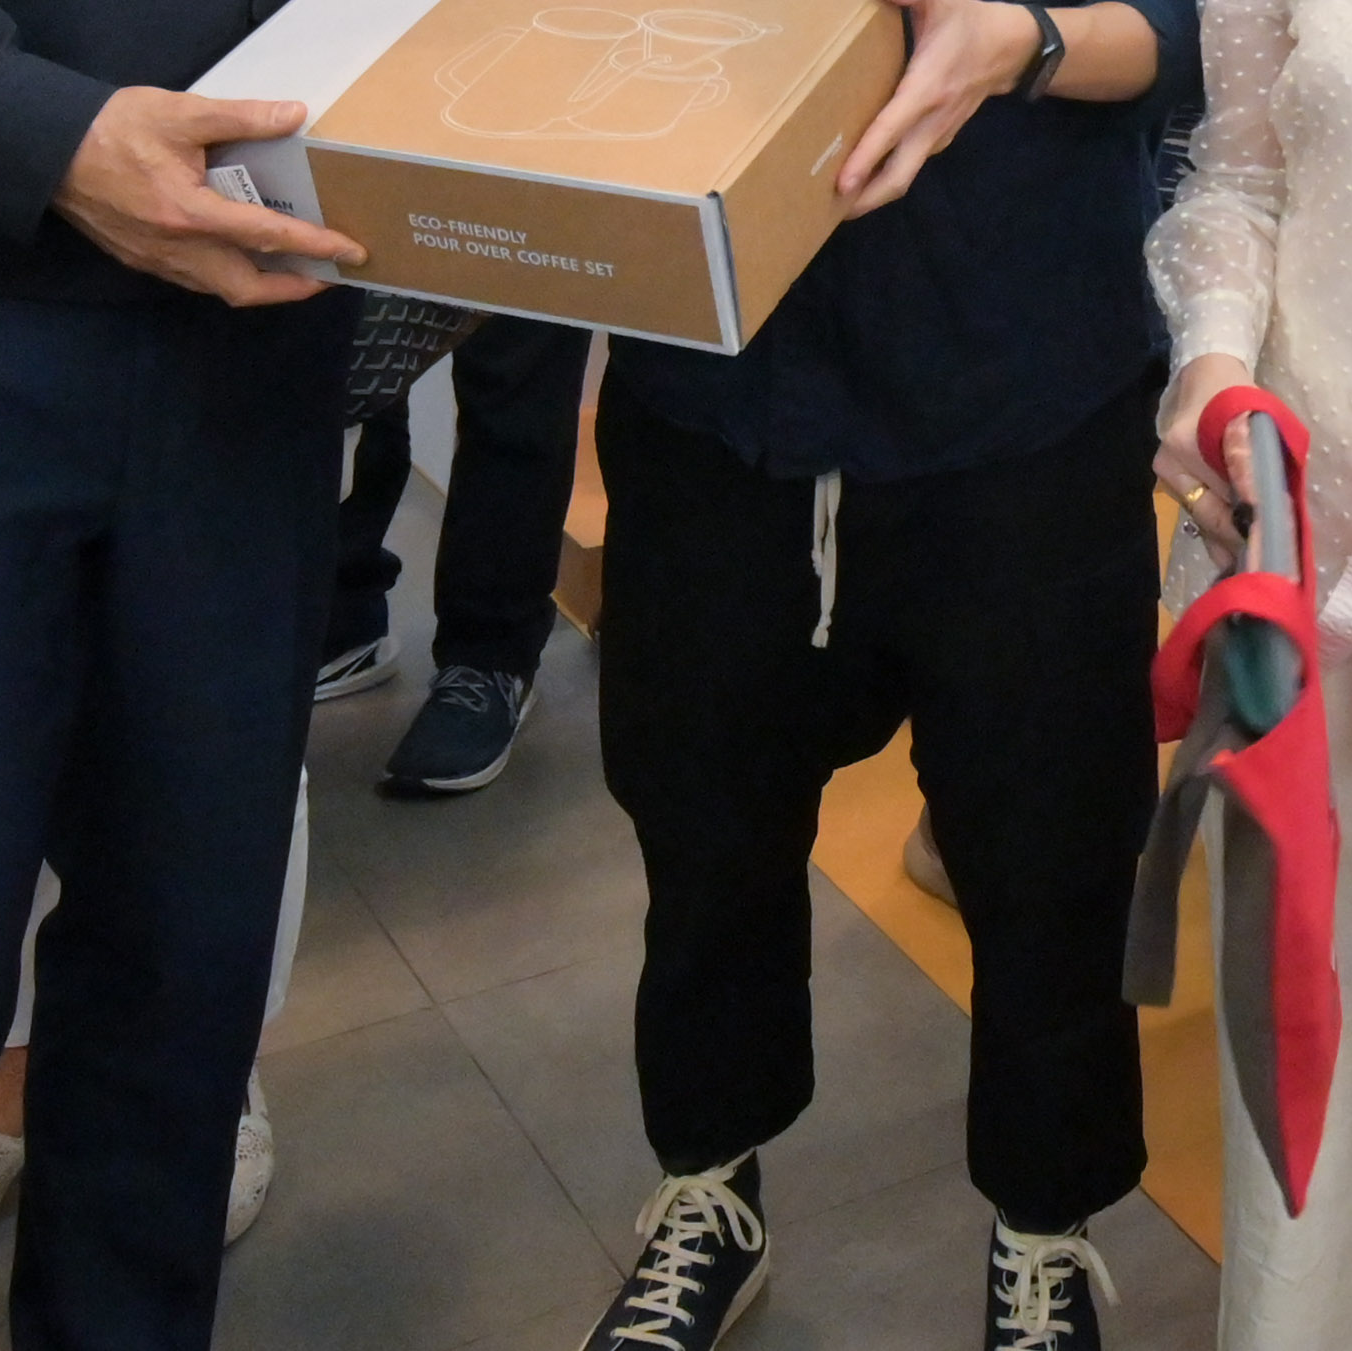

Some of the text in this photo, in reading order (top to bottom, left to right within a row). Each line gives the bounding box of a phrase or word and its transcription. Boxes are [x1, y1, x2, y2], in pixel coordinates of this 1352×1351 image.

[261, 196, 294, 211] MAN
[409, 214, 527, 245] ECO-FRIENDLY
[413, 232, 614, 277] POUR OVER COFFEE SET
